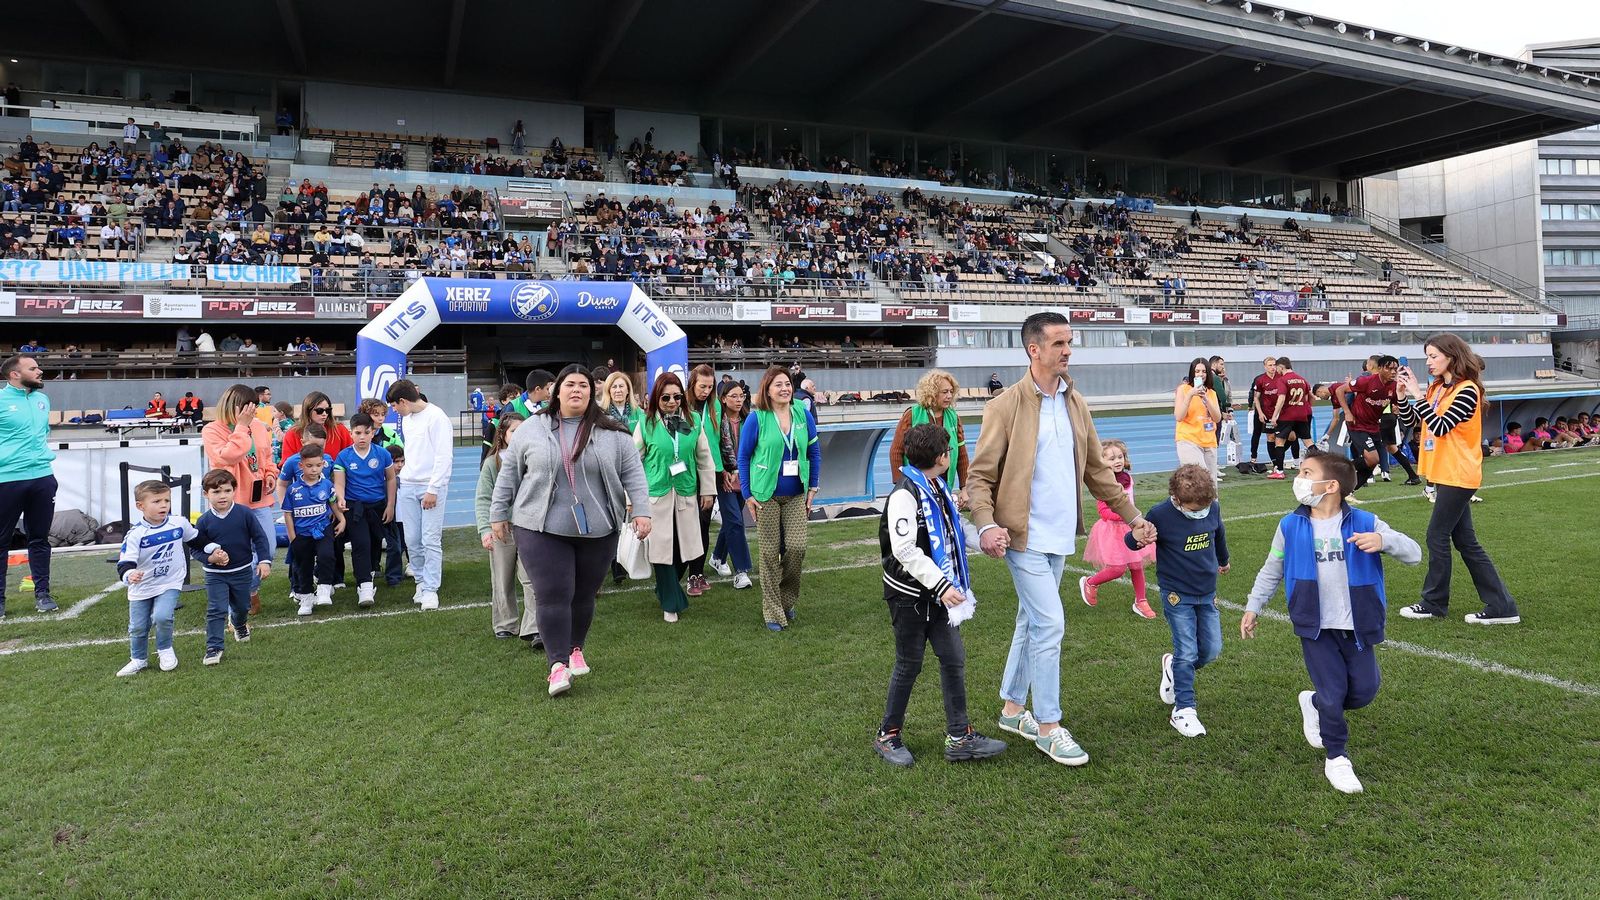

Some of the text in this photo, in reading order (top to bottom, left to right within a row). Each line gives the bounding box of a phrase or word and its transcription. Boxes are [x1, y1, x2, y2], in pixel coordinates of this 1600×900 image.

[58, 259, 108, 280] UNA
[213, 264, 297, 283] LUCHAR
[445, 286, 491, 301] XEREZ
[577, 291, 620, 308] Diver
[448, 301, 488, 312] DEPORTIVO
[691, 306, 701, 315] DE
[1289, 387, 1304, 401] 22
[1186, 533, 1209, 544] KEEP
[1184, 540, 1210, 552] GOING
